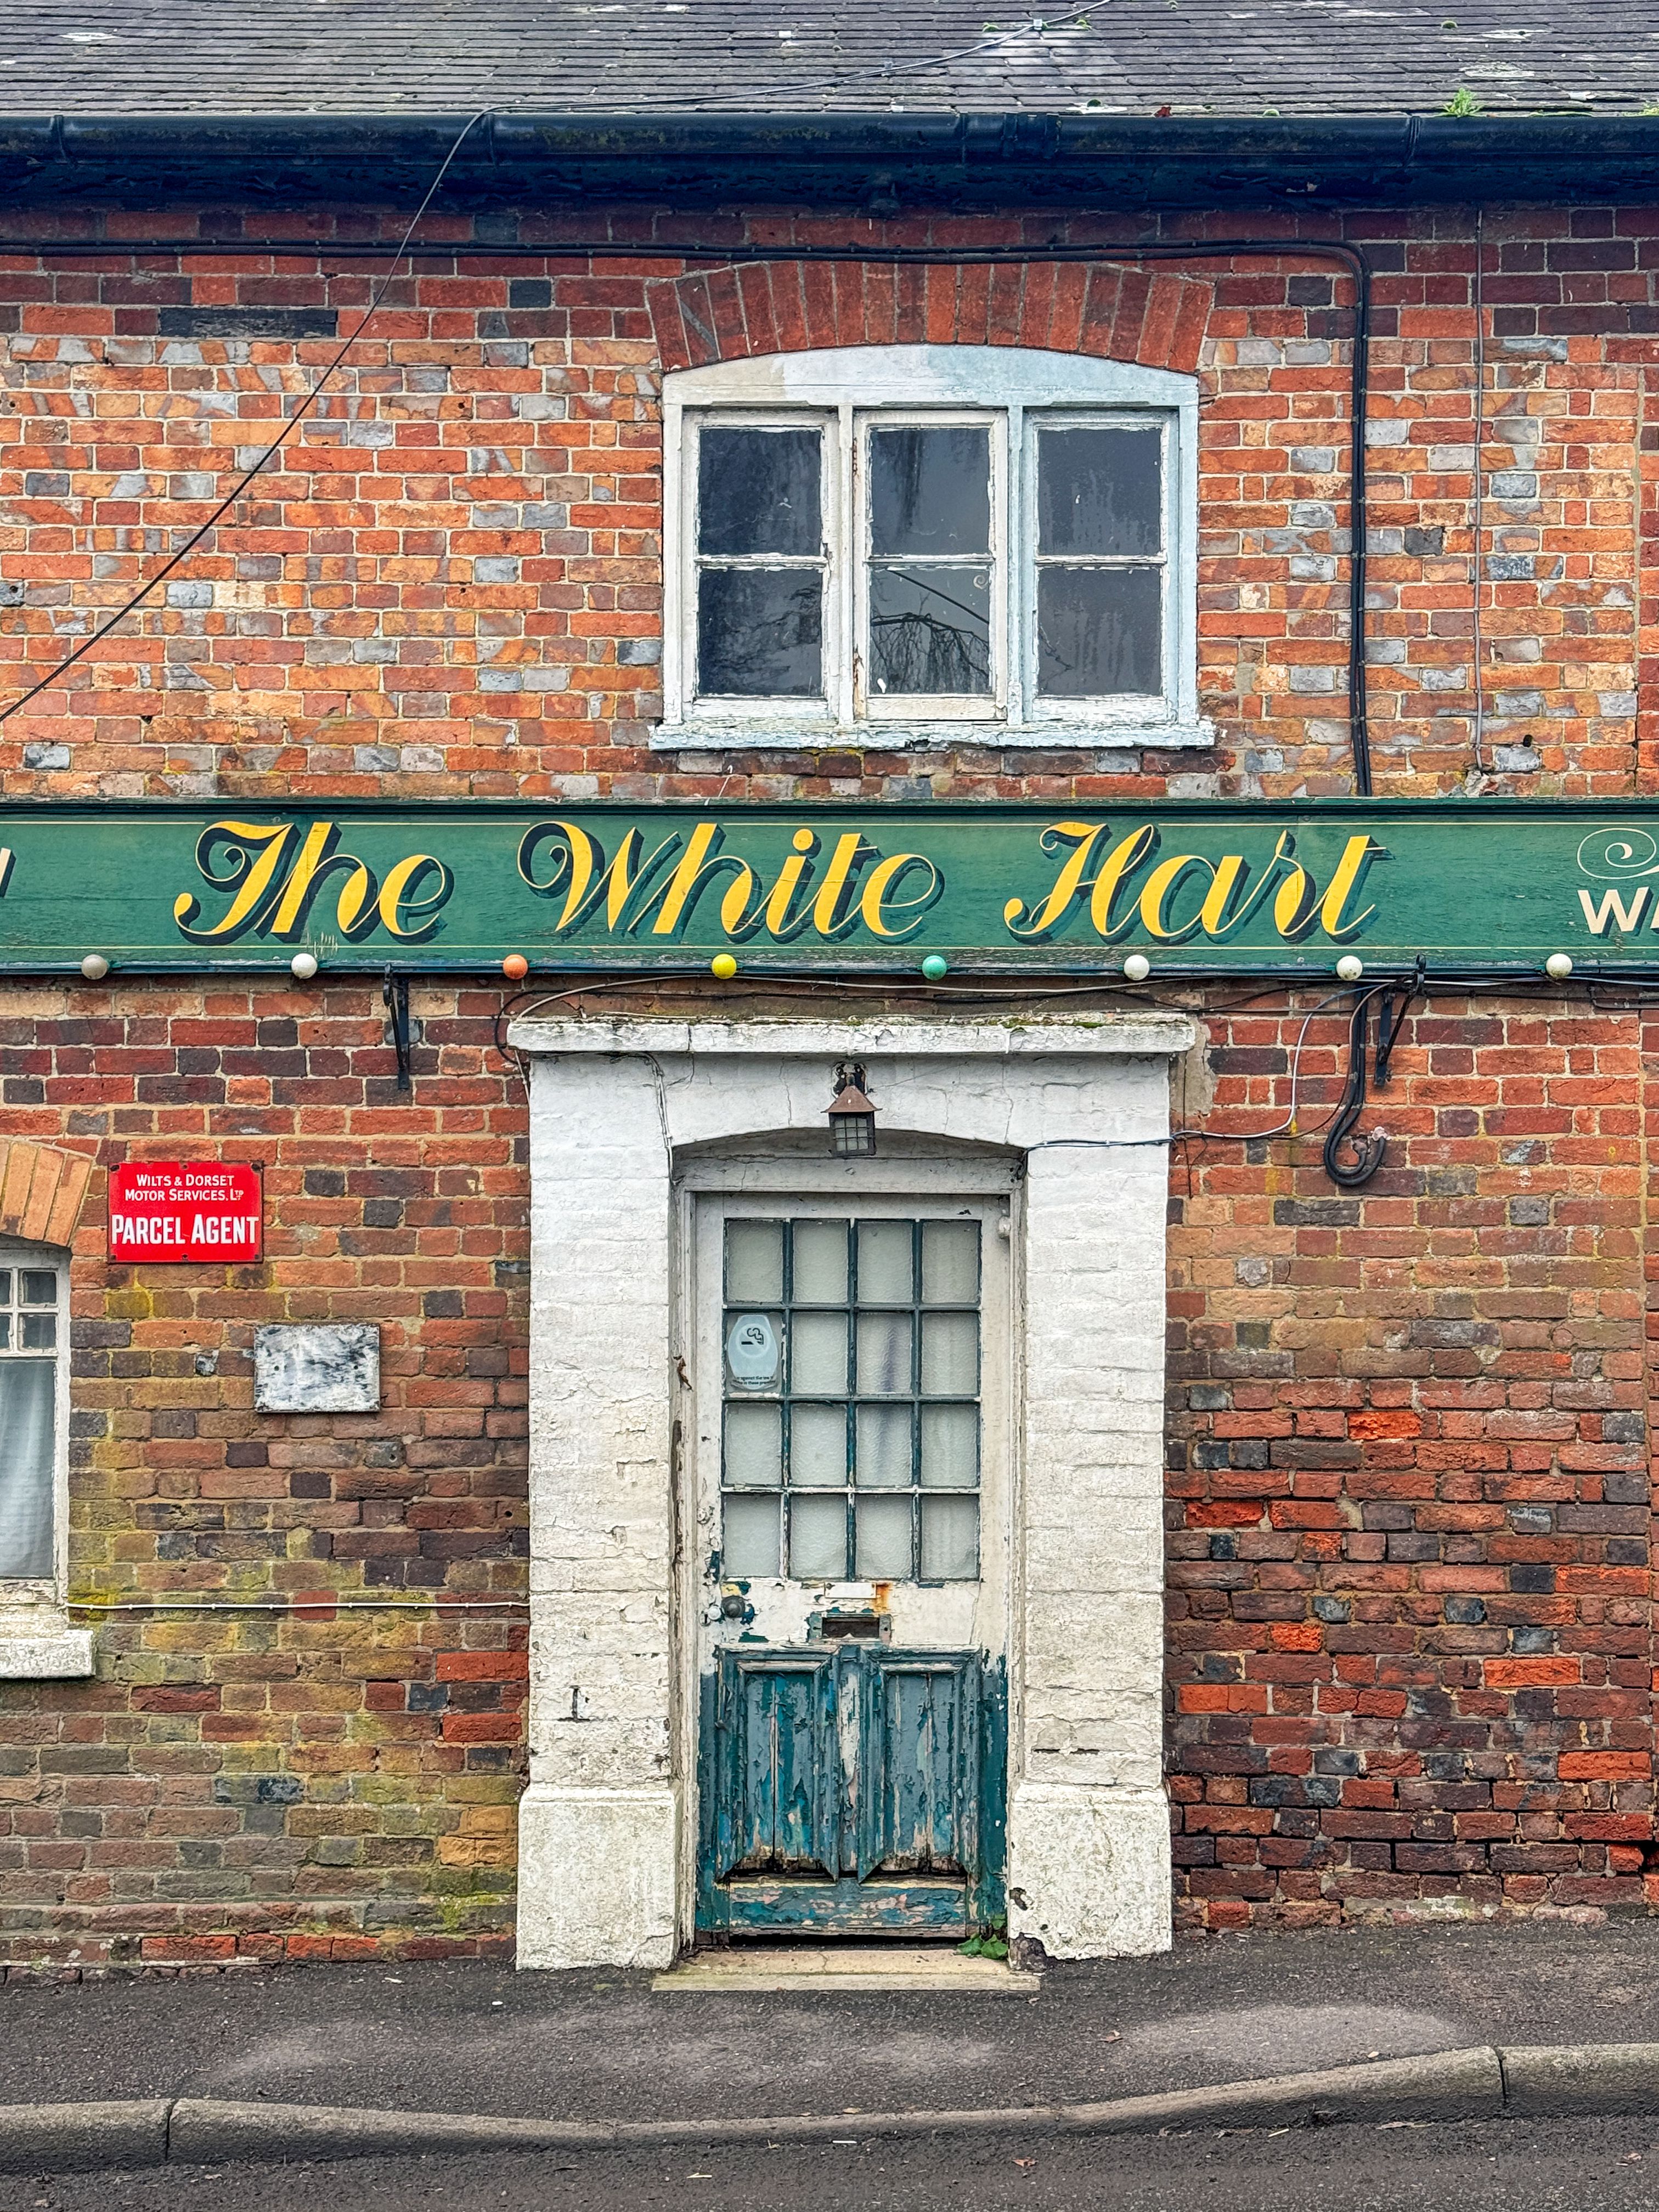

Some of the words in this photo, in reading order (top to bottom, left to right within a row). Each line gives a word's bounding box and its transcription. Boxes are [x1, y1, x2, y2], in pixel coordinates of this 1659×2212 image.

[173, 821, 447, 936] The
[515, 821, 924, 936] White
[1003, 821, 1387, 938] Hart
[136, 1173, 171, 1187] WILTS
[174, 1175, 183, 1187] &
[185, 1174, 234, 1187] DORSET
[125, 1189, 165, 1201] MOTOR
[111, 1214, 185, 1244] PARCEL
[191, 1214, 259, 1244] AGENT
